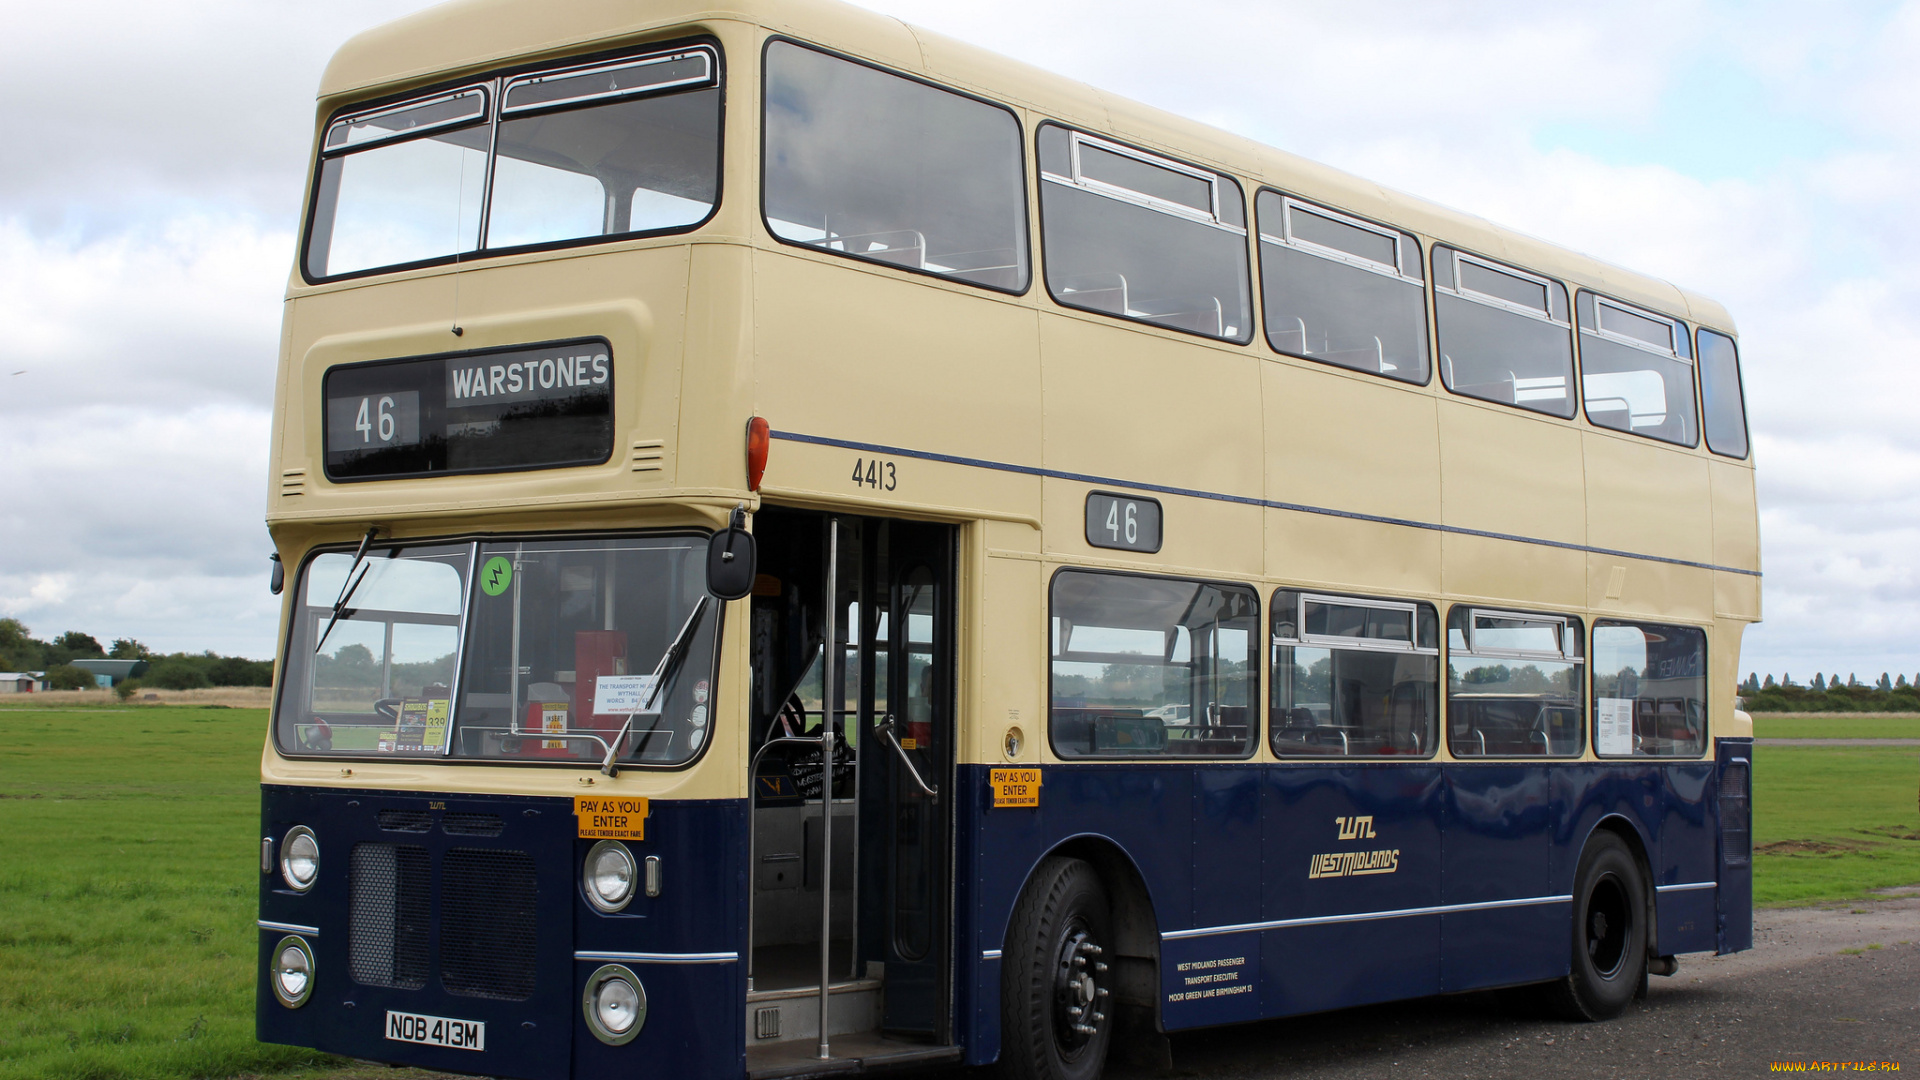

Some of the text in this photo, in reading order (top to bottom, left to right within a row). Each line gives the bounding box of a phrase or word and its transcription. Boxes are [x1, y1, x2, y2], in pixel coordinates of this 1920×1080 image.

[452, 353, 609, 399] WARSTONES
[355, 396, 395, 443] 46
[852, 458, 896, 491] 4413
[1106, 500, 1137, 544] 46
[994, 772, 1036, 782] PAY AS YOU
[1003, 785, 1027, 795] ENTER
[580, 801, 641, 813] PAY AS YOU
[593, 815, 628, 828] ENTER
[580, 829, 597, 837] PLEASE
[597, 829, 614, 837] TENDER
[630, 830, 642, 838] FARE
[1177, 957, 1245, 972] WEST MIDLANDS PASSENGER
[1184, 971, 1238, 986] TRANSPORT EXECUTIVE
[1168, 984, 1253, 1002] MOOR GREEN LANE BIRMINGHAM 13
[390, 1014, 478, 1048] NOB 413M
